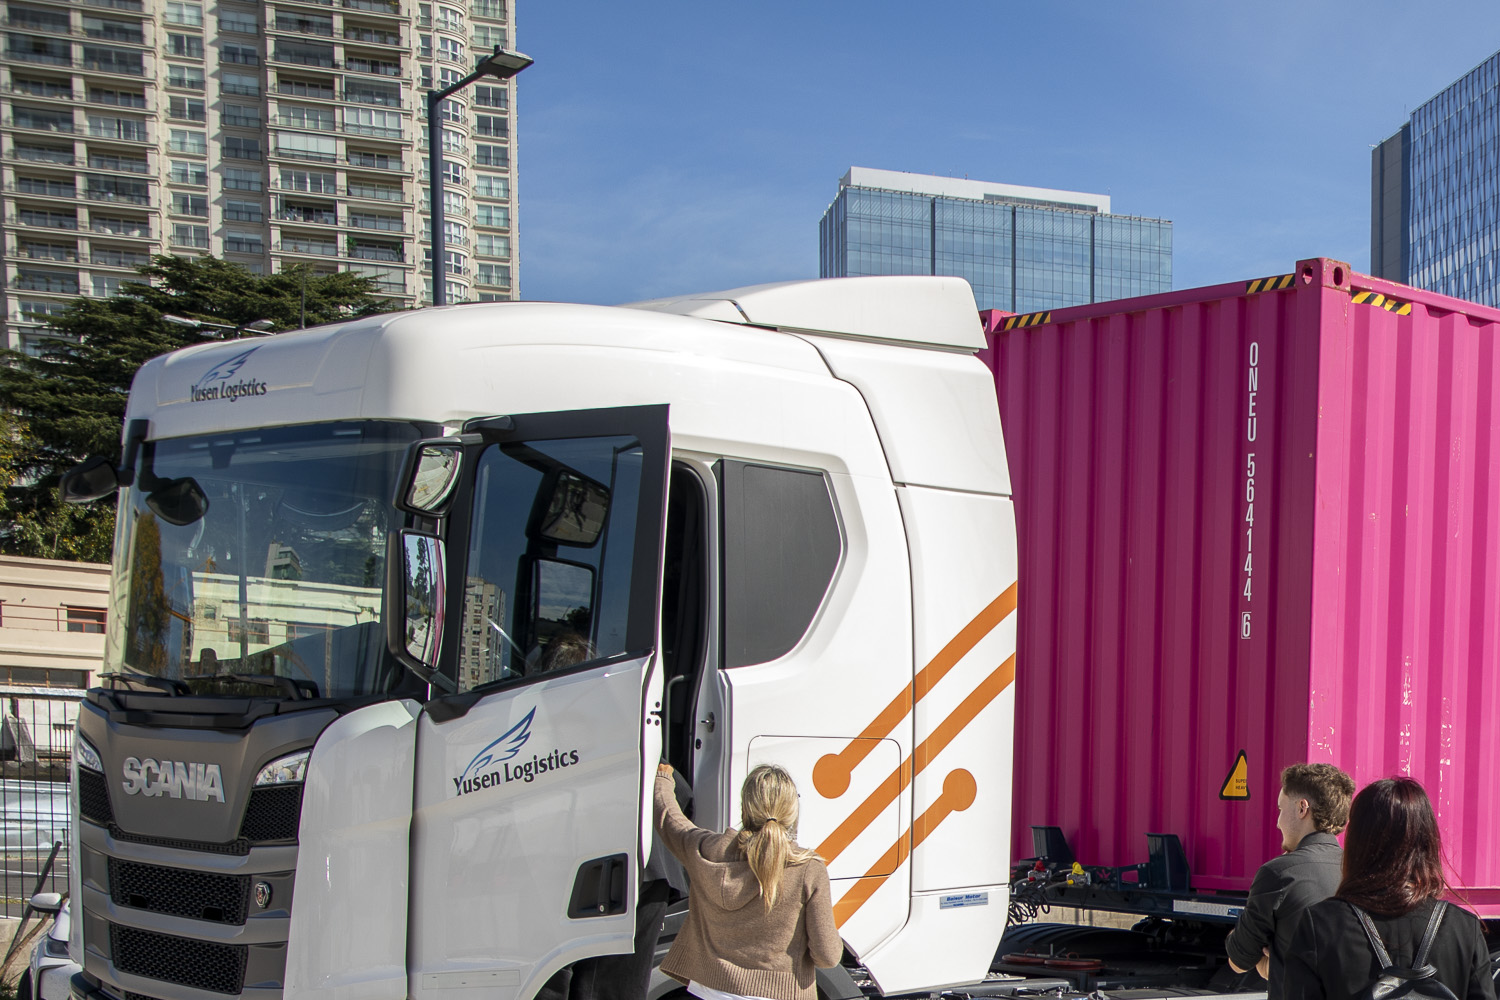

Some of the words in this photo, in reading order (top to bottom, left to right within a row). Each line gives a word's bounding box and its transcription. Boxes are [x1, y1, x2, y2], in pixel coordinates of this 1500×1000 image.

[191, 383, 219, 402] Yusen
[221, 378, 267, 402] Logistics
[1247, 342, 1259, 442] ONEU
[1243, 453, 1255, 602] 564144
[122, 756, 226, 804] SCANIA
[453, 771, 501, 797] Yusen
[504, 749, 580, 783] Logistics
